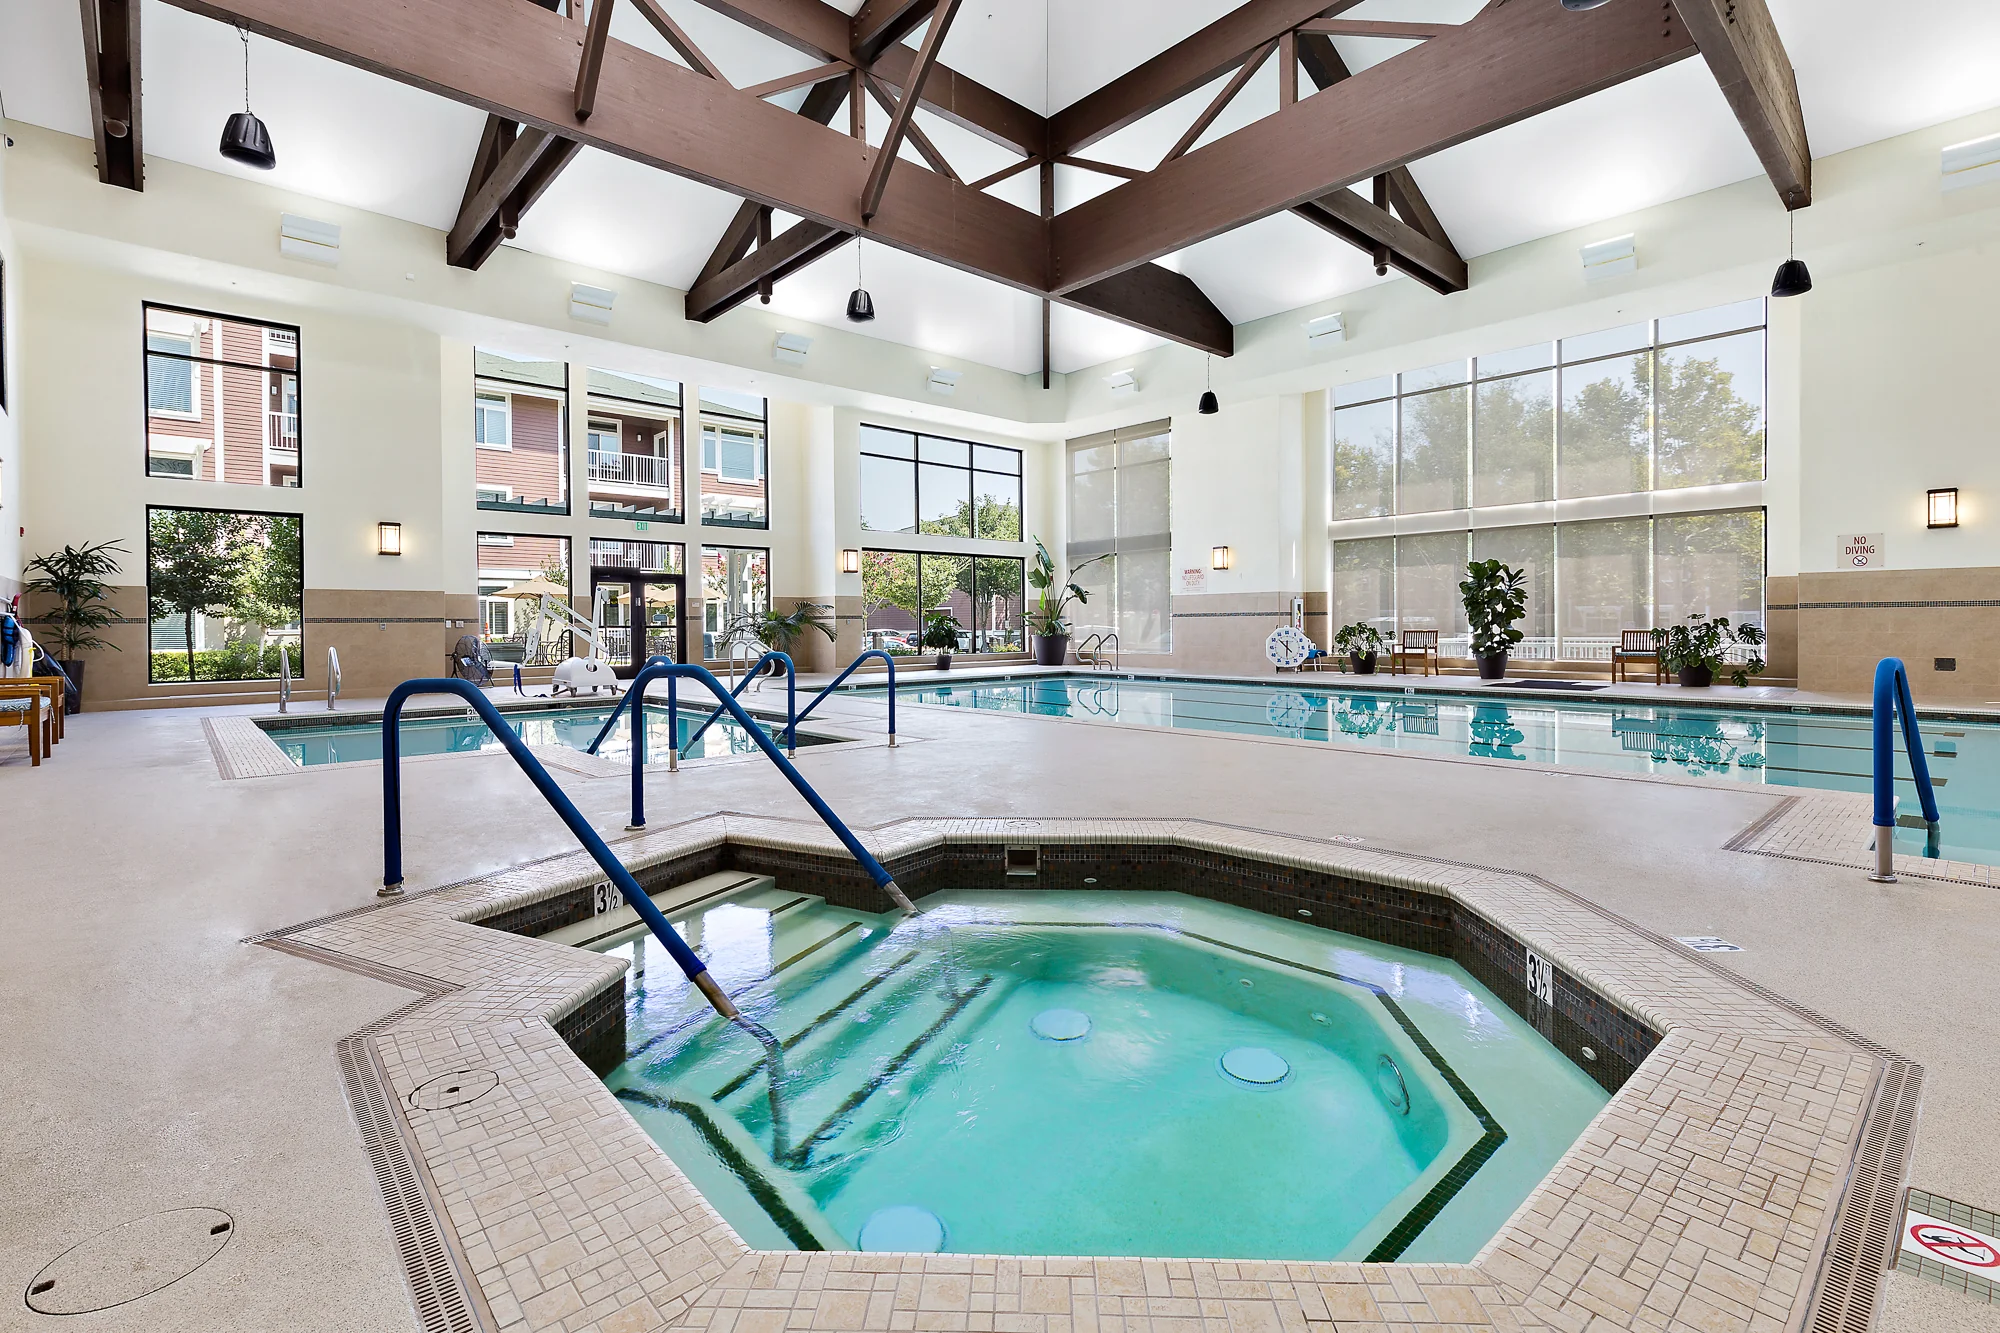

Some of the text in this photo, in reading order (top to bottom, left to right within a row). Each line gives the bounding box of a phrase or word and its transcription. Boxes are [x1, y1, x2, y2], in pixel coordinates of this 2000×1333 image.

[636, 521, 648, 531] EXIT
[1853, 536, 1867, 545] NO
[1845, 545, 1875, 555] DIVING
